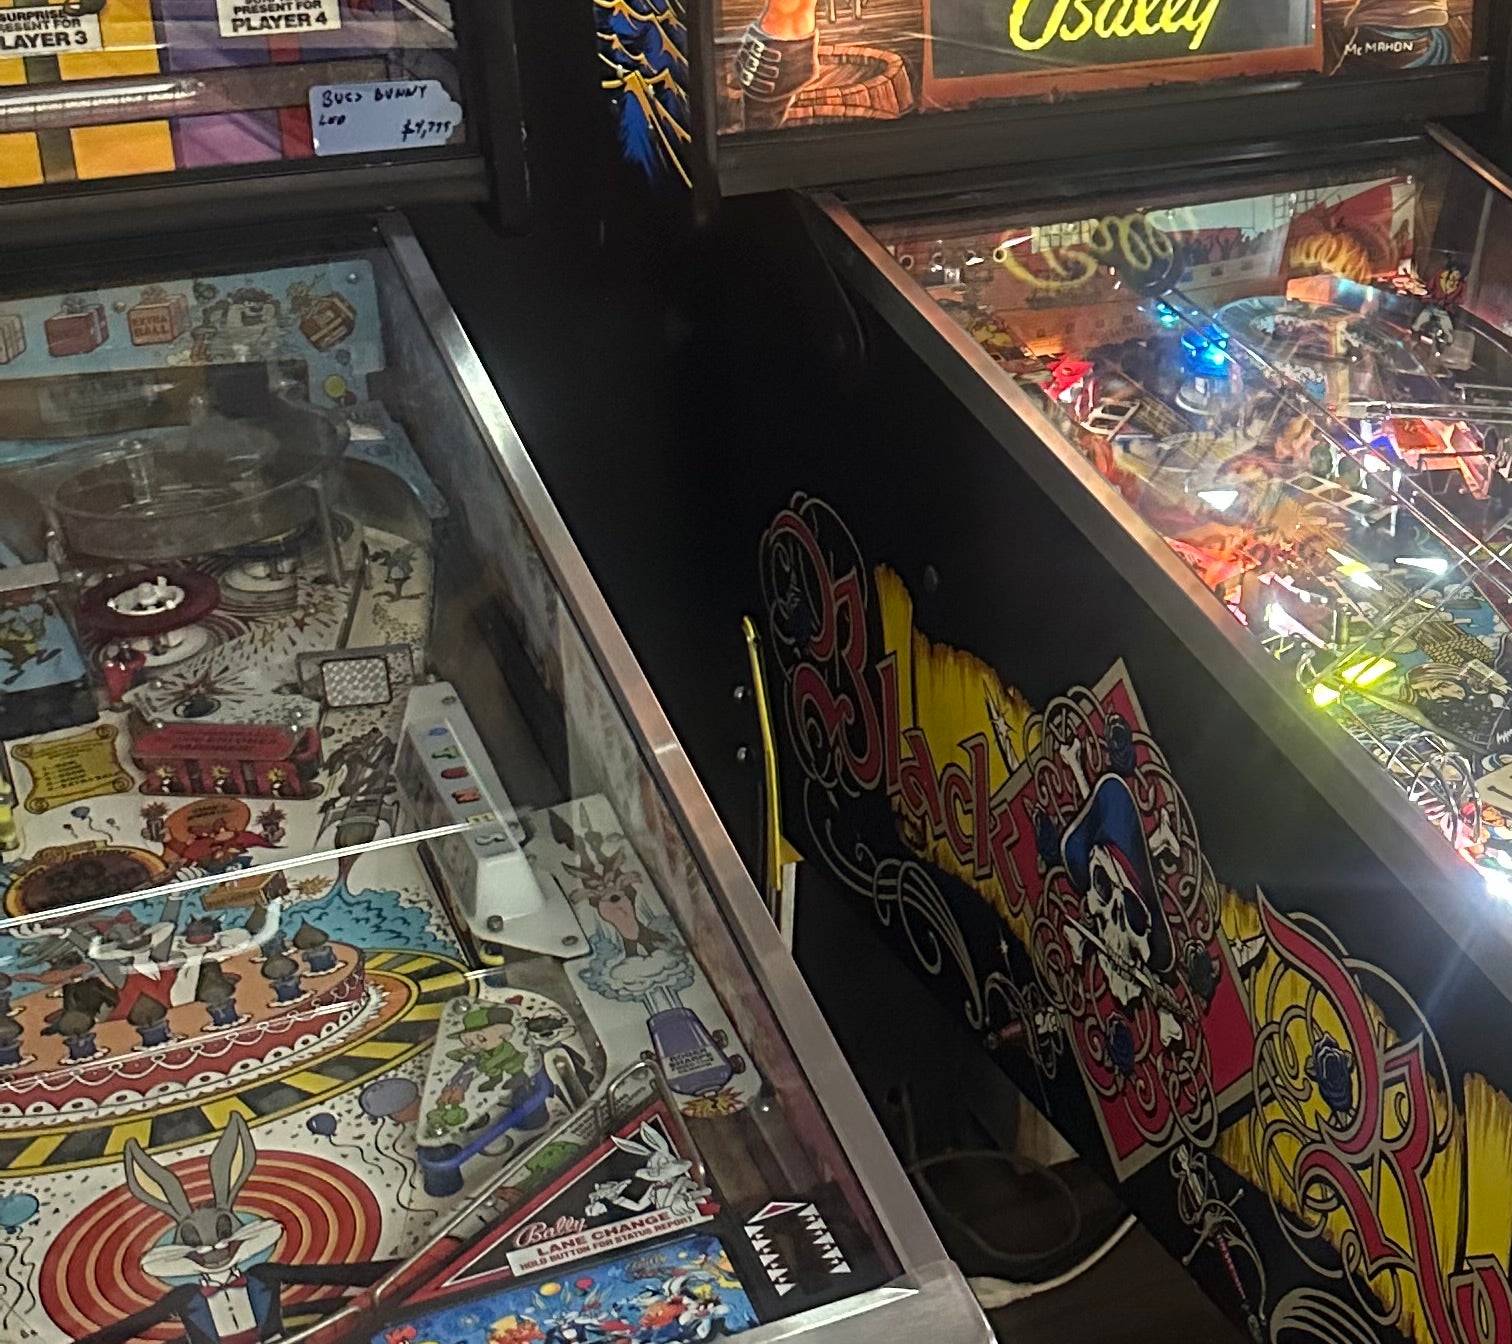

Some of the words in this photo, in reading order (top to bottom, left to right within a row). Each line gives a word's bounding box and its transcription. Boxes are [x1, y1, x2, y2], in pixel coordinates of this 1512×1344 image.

[233, 2, 297, 16] PRESENT
[299, 0, 322, 12] FOR
[54, 18, 81, 30] FOR
[231, 13, 311, 33] PLAYER
[314, 11, 329, 25] 4
[0, 31, 71, 50] LAYER
[75, 30, 88, 45] 3
[374, 86, 428, 102] BUNNY
[515, 1216, 588, 1248] Bally
[536, 1237, 588, 1256] LANE
[591, 1212, 672, 1240] CHANGE
[520, 1257, 548, 1271] HOLD
[550, 1245, 591, 1262] BUTTON
[592, 1238, 614, 1251] FOR
[615, 1227, 653, 1245] STATUS
[654, 1215, 694, 1234] REPORT
